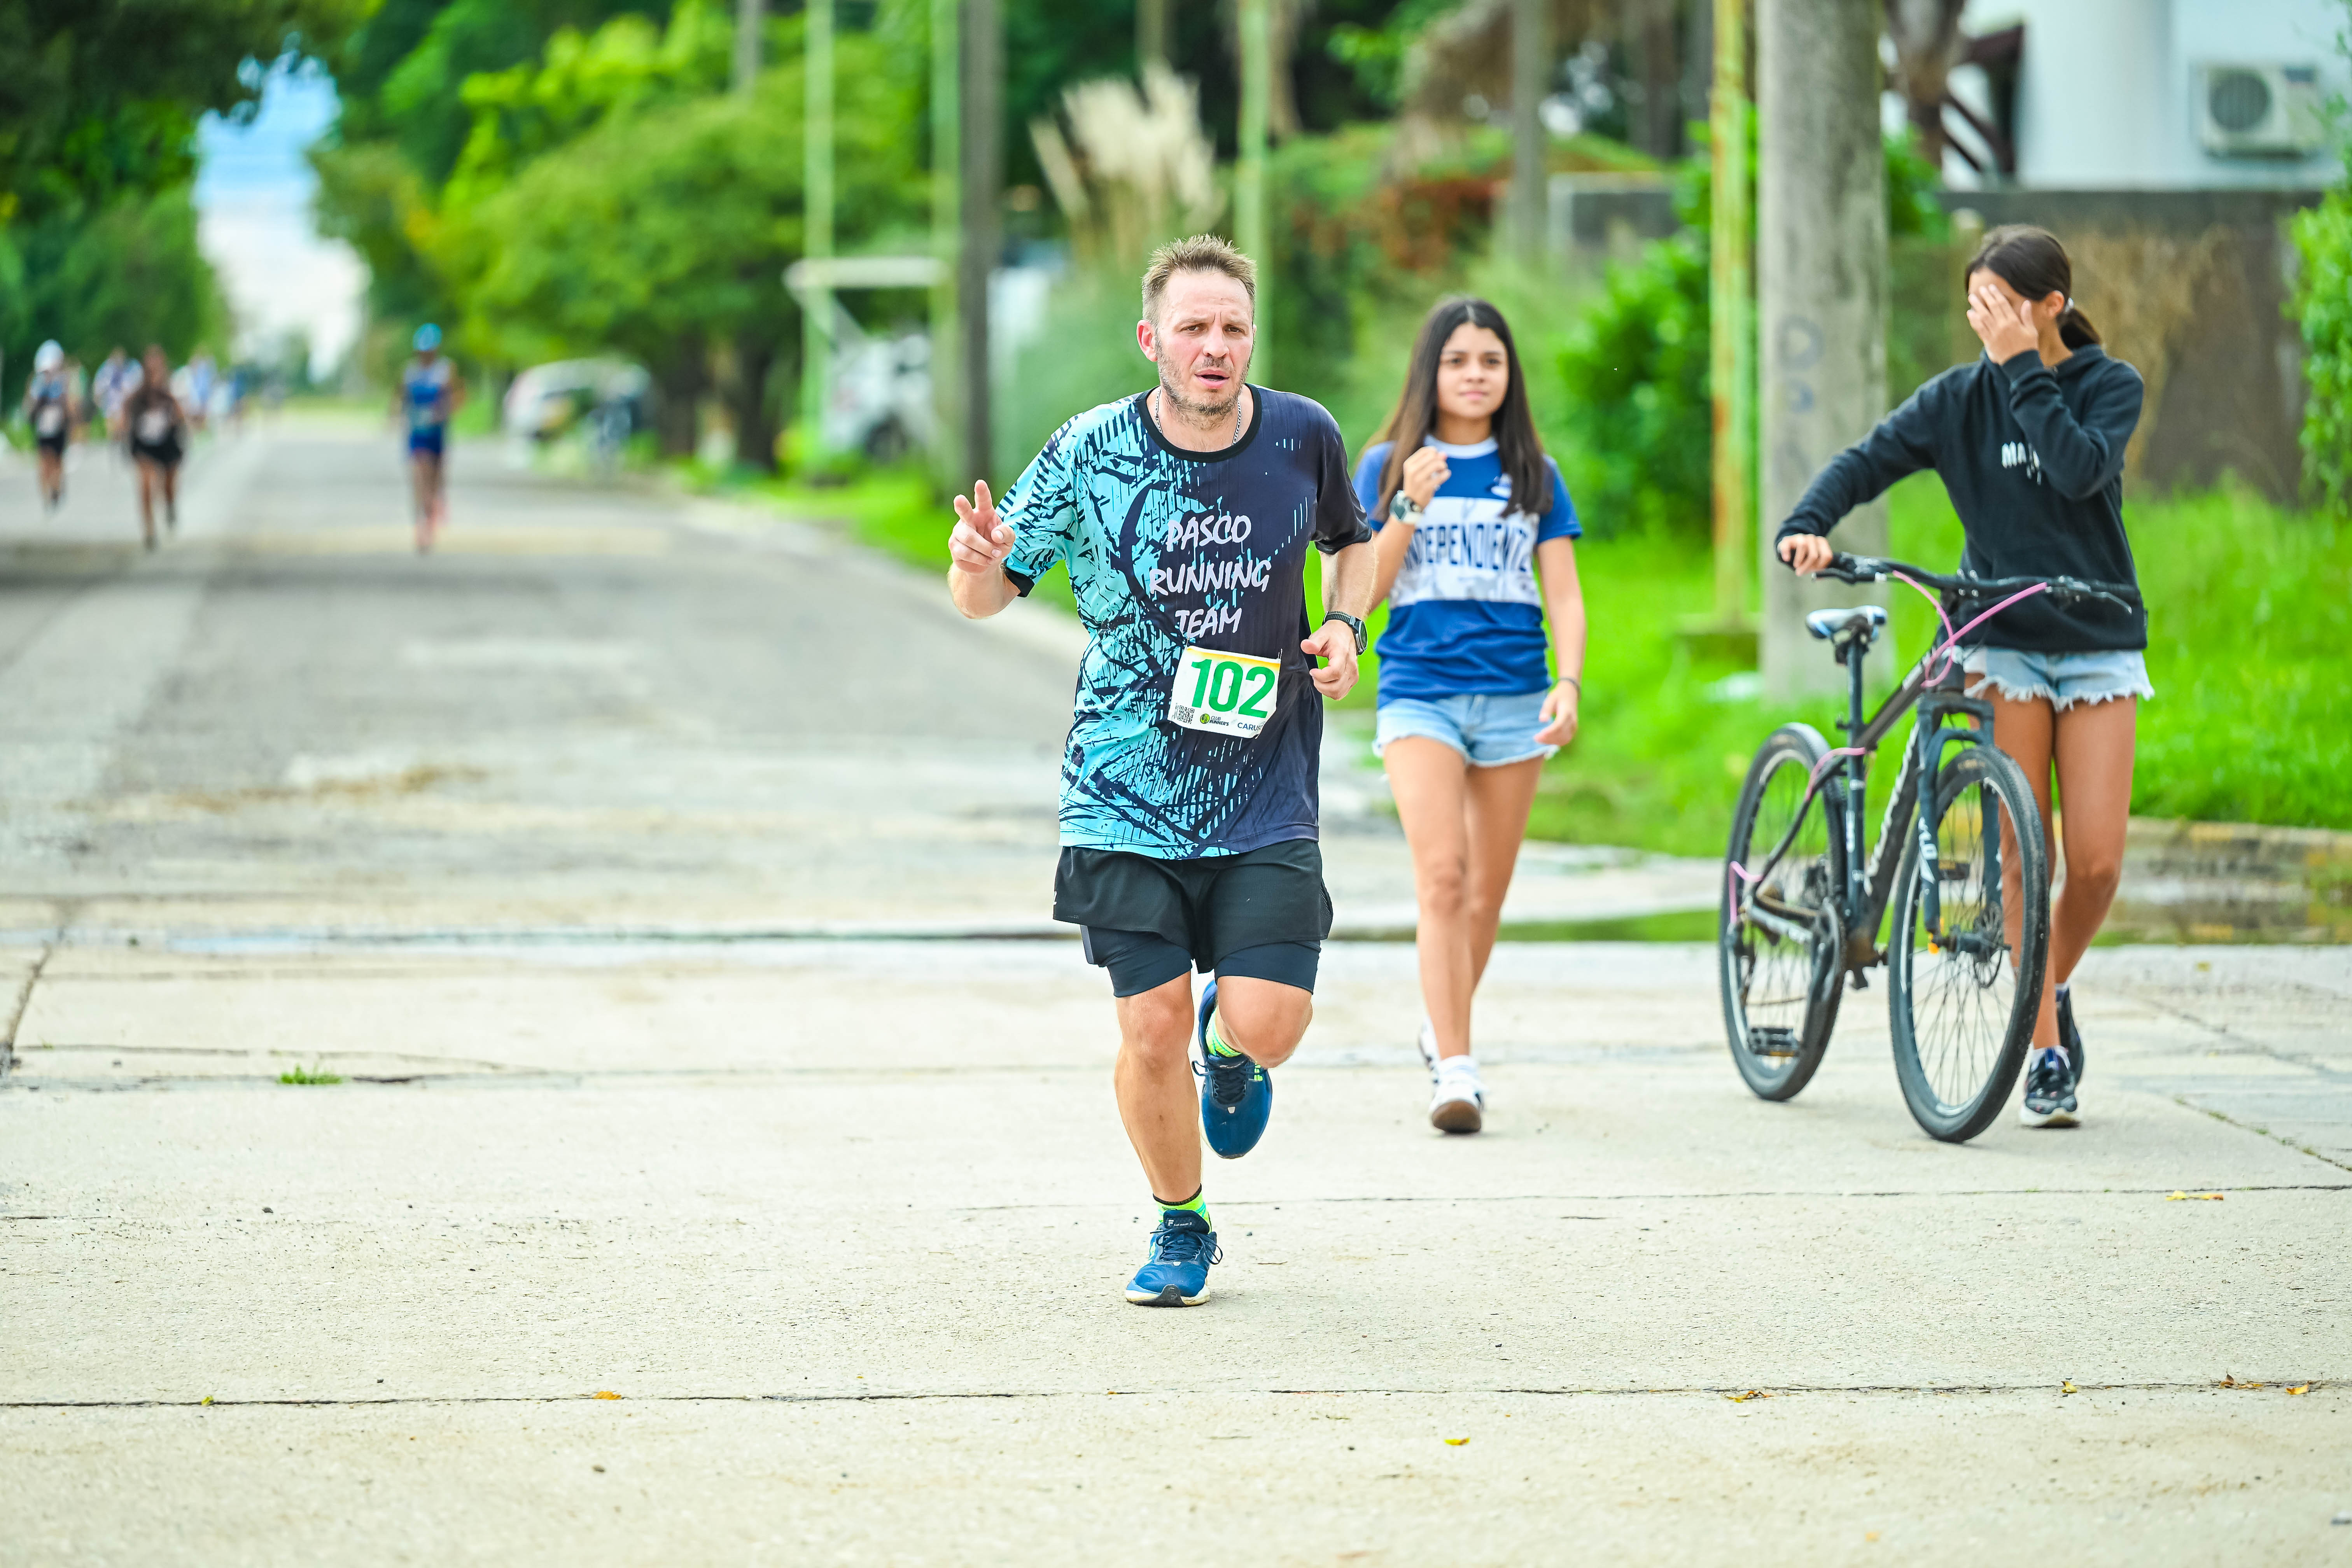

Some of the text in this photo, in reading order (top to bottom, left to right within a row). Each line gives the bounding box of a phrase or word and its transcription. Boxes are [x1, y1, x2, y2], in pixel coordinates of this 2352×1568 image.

[1166, 514, 1251, 552] PASCO
[1149, 560, 1272, 596] RUNNING
[1175, 605, 1242, 638] TEAM
[1191, 659, 1275, 718] 102
